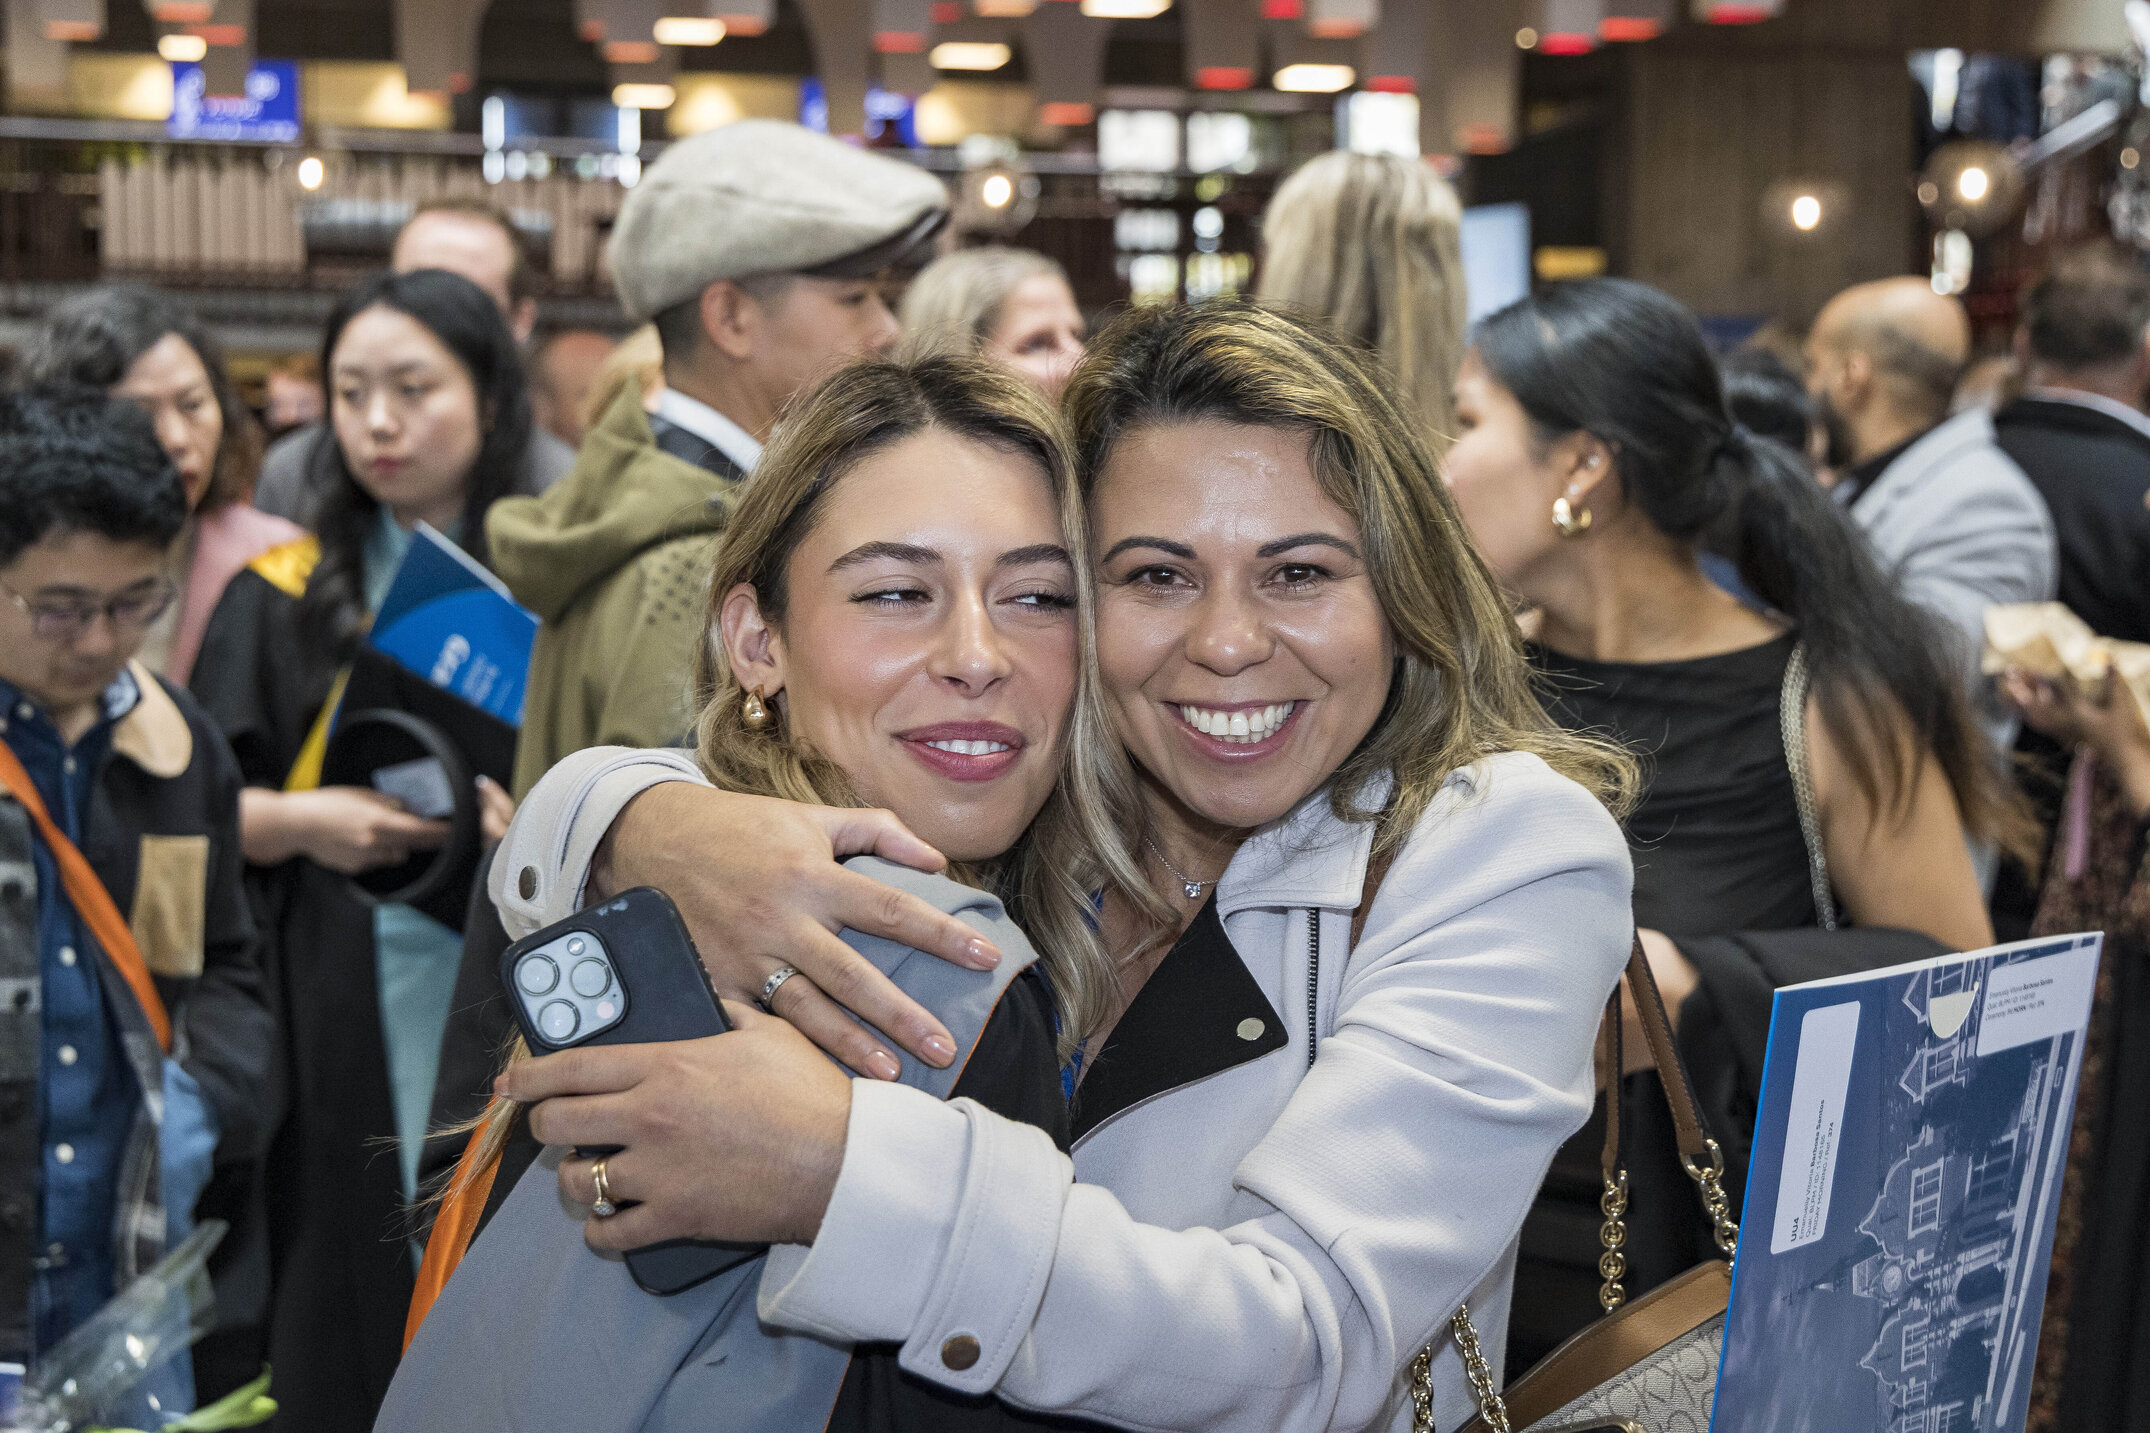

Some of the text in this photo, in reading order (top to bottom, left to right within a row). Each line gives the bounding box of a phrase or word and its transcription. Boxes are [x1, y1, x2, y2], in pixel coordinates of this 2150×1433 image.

[1810, 1131, 1820, 1167] Barbosa
[1816, 1098, 1825, 1130] Santos
[1791, 1216, 1799, 1242] UU4
